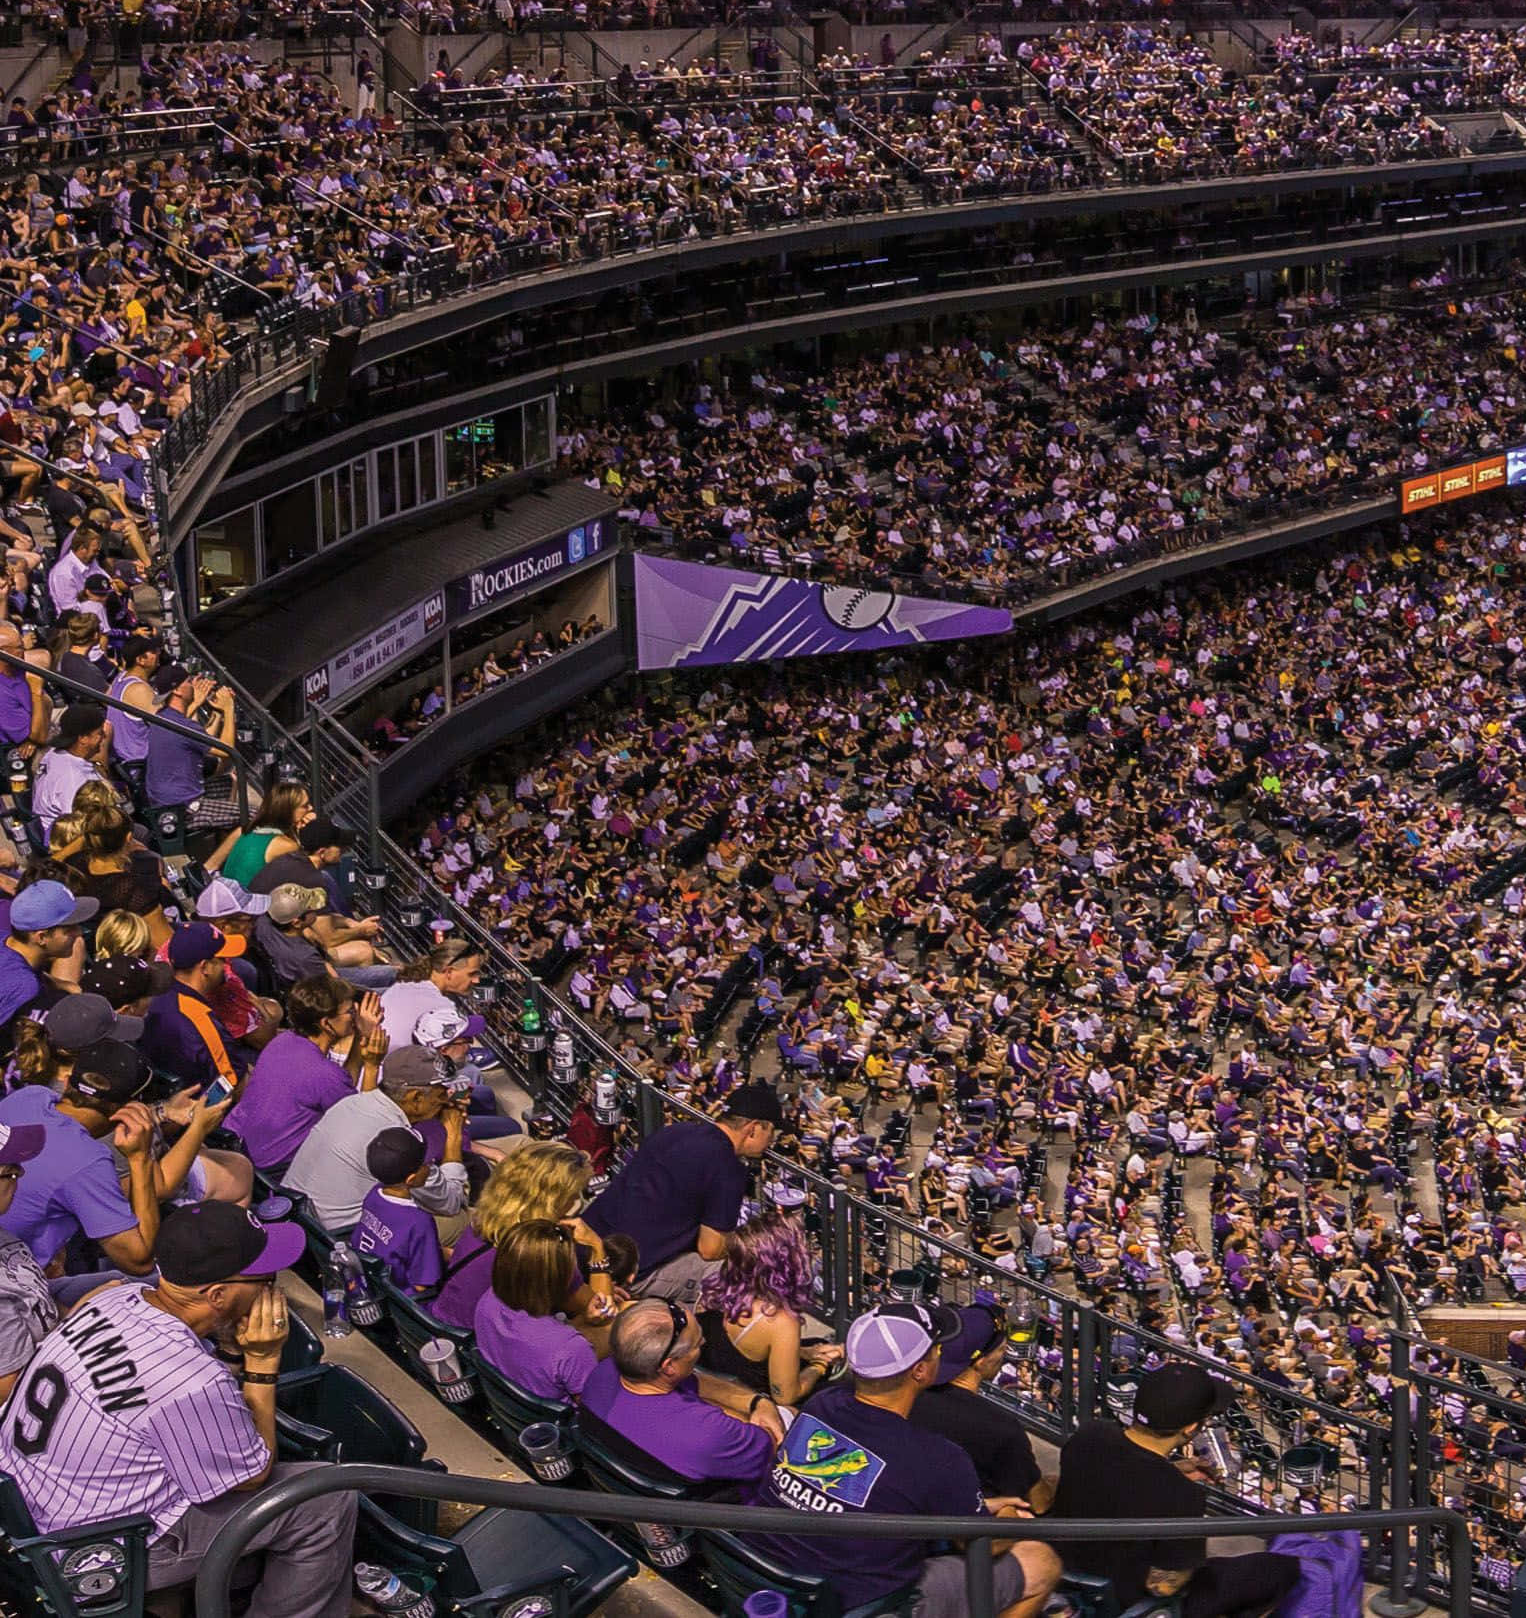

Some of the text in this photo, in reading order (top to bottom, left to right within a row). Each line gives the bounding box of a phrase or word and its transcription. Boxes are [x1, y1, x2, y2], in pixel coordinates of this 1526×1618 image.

[1443, 475, 1471, 492] STIHL
[1477, 465, 1505, 483] STIHL
[1407, 485, 1437, 502] STIHL
[467, 550, 563, 611] ROCKIES.com
[425, 595, 443, 621] KOA
[353, 639, 373, 663] TRAFFIC
[365, 657, 376, 675] AM
[305, 665, 328, 696] KOA
[13, 1363, 71, 1456] 9
[91, 1579, 102, 1589] 4
